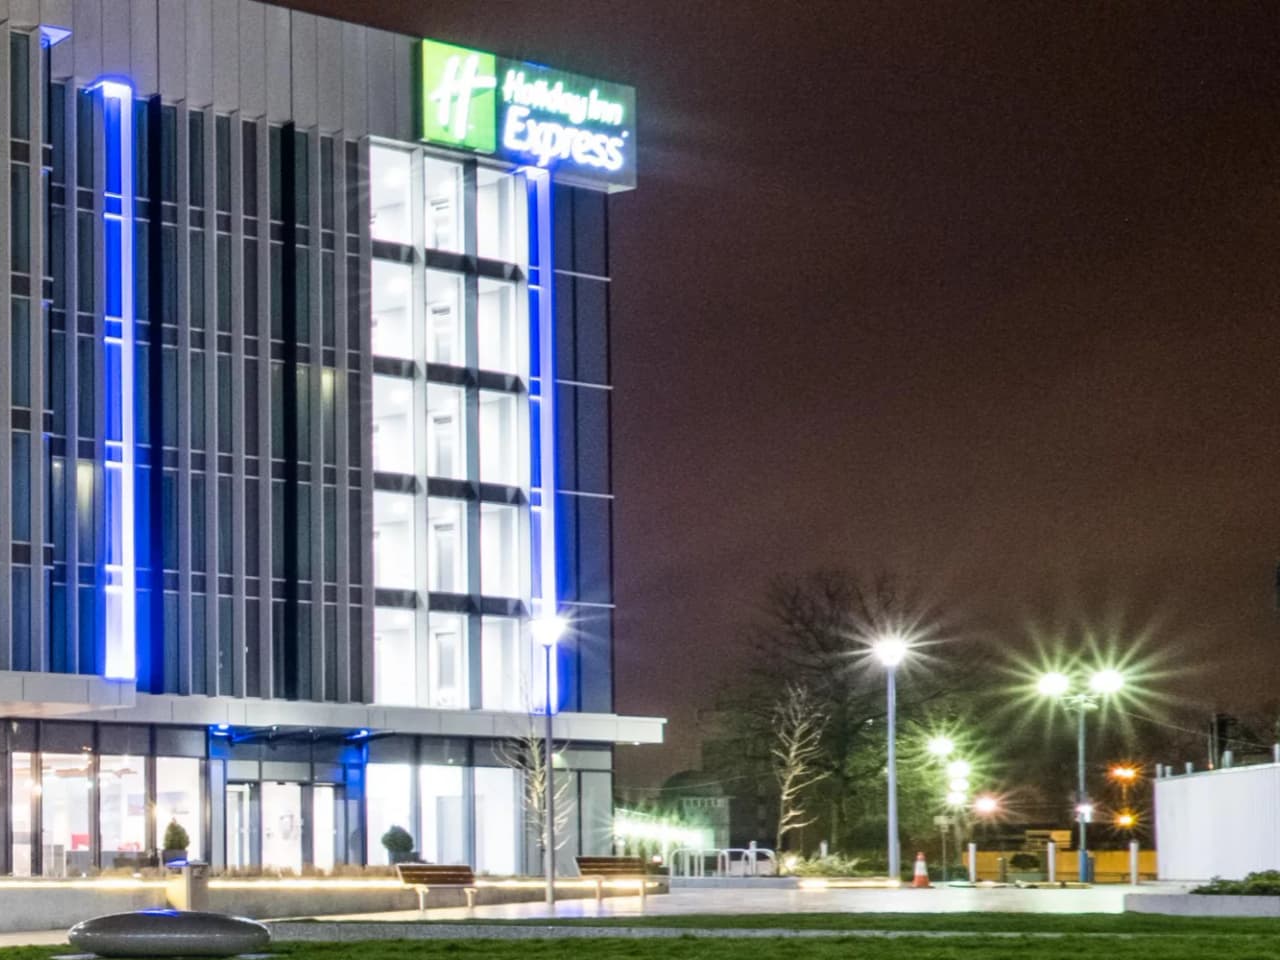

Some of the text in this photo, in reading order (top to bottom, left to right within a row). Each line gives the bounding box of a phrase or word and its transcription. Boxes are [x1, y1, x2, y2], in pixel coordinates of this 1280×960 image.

[502, 69, 624, 125] Holiday Inn
[503, 104, 625, 171] Express
